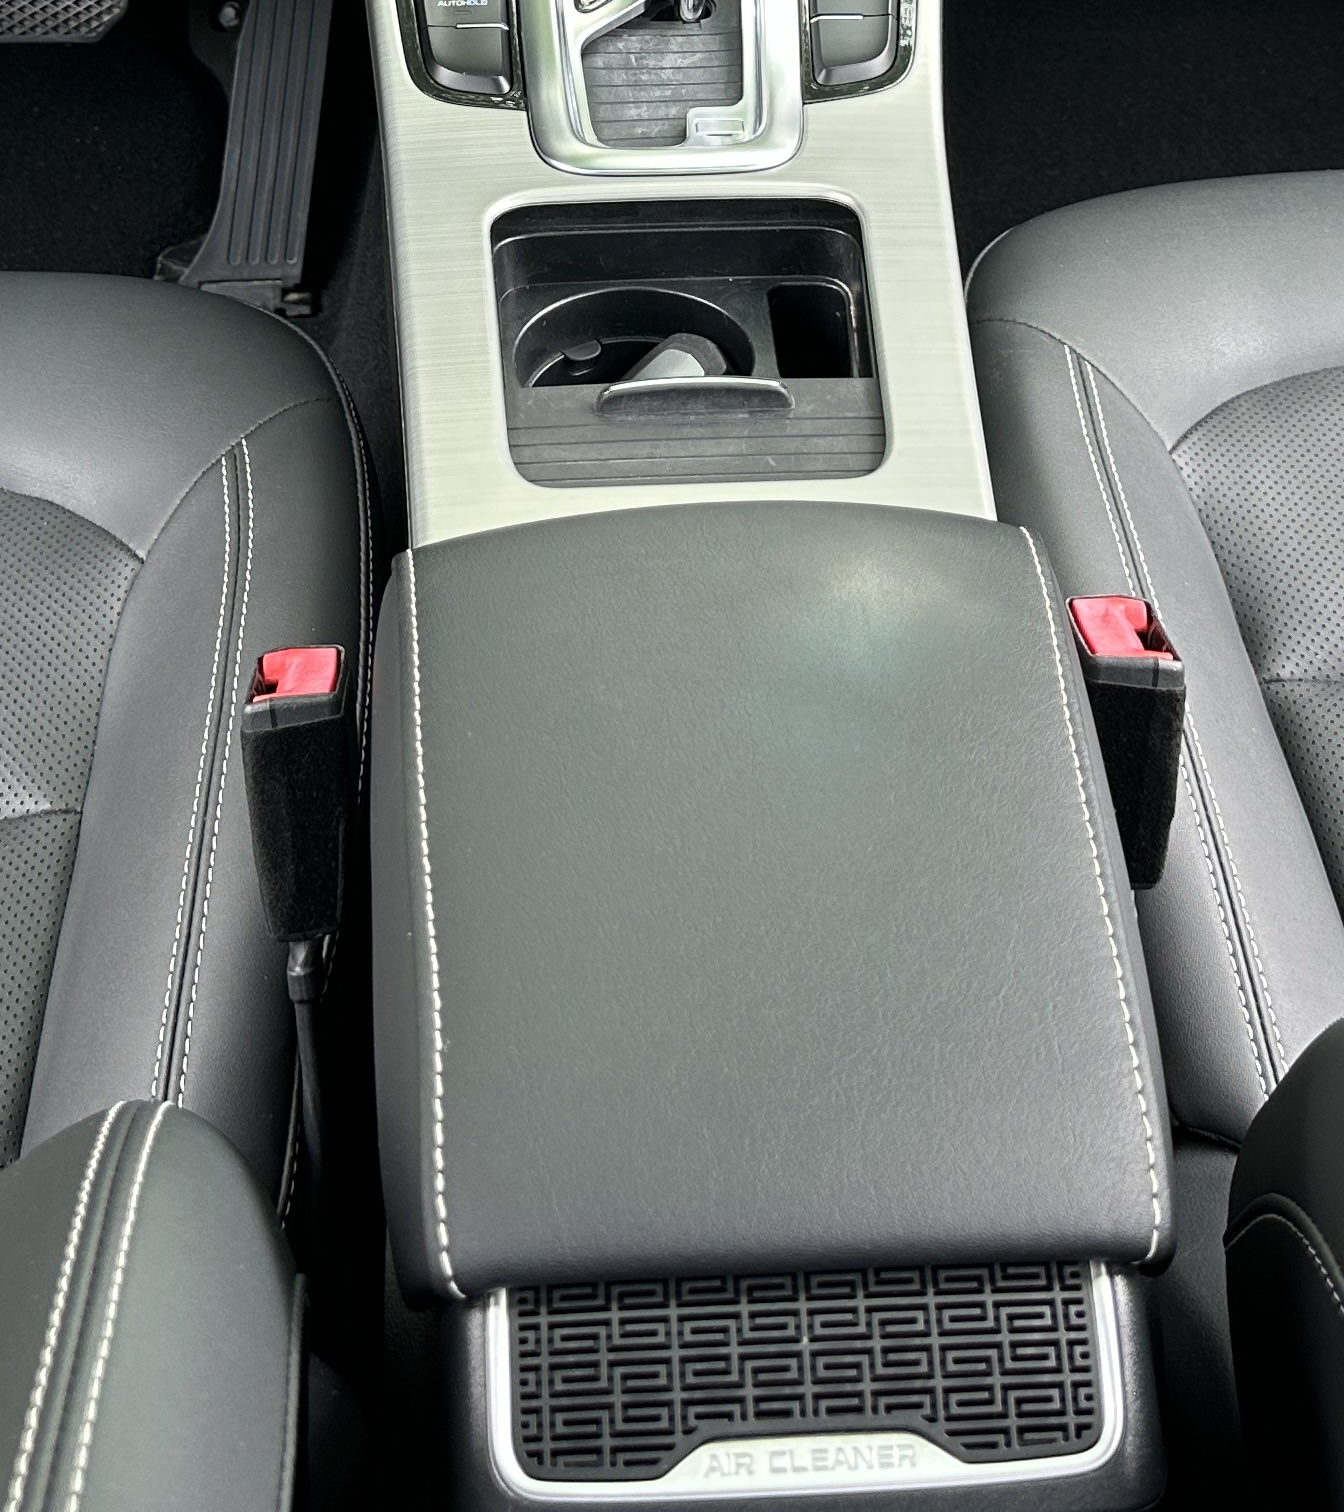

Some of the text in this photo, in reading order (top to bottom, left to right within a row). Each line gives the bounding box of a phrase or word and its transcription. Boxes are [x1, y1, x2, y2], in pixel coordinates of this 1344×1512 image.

[437, 0, 488, 7] AUTOHOLD
[703, 1444, 917, 1478] AIR CLEANER
